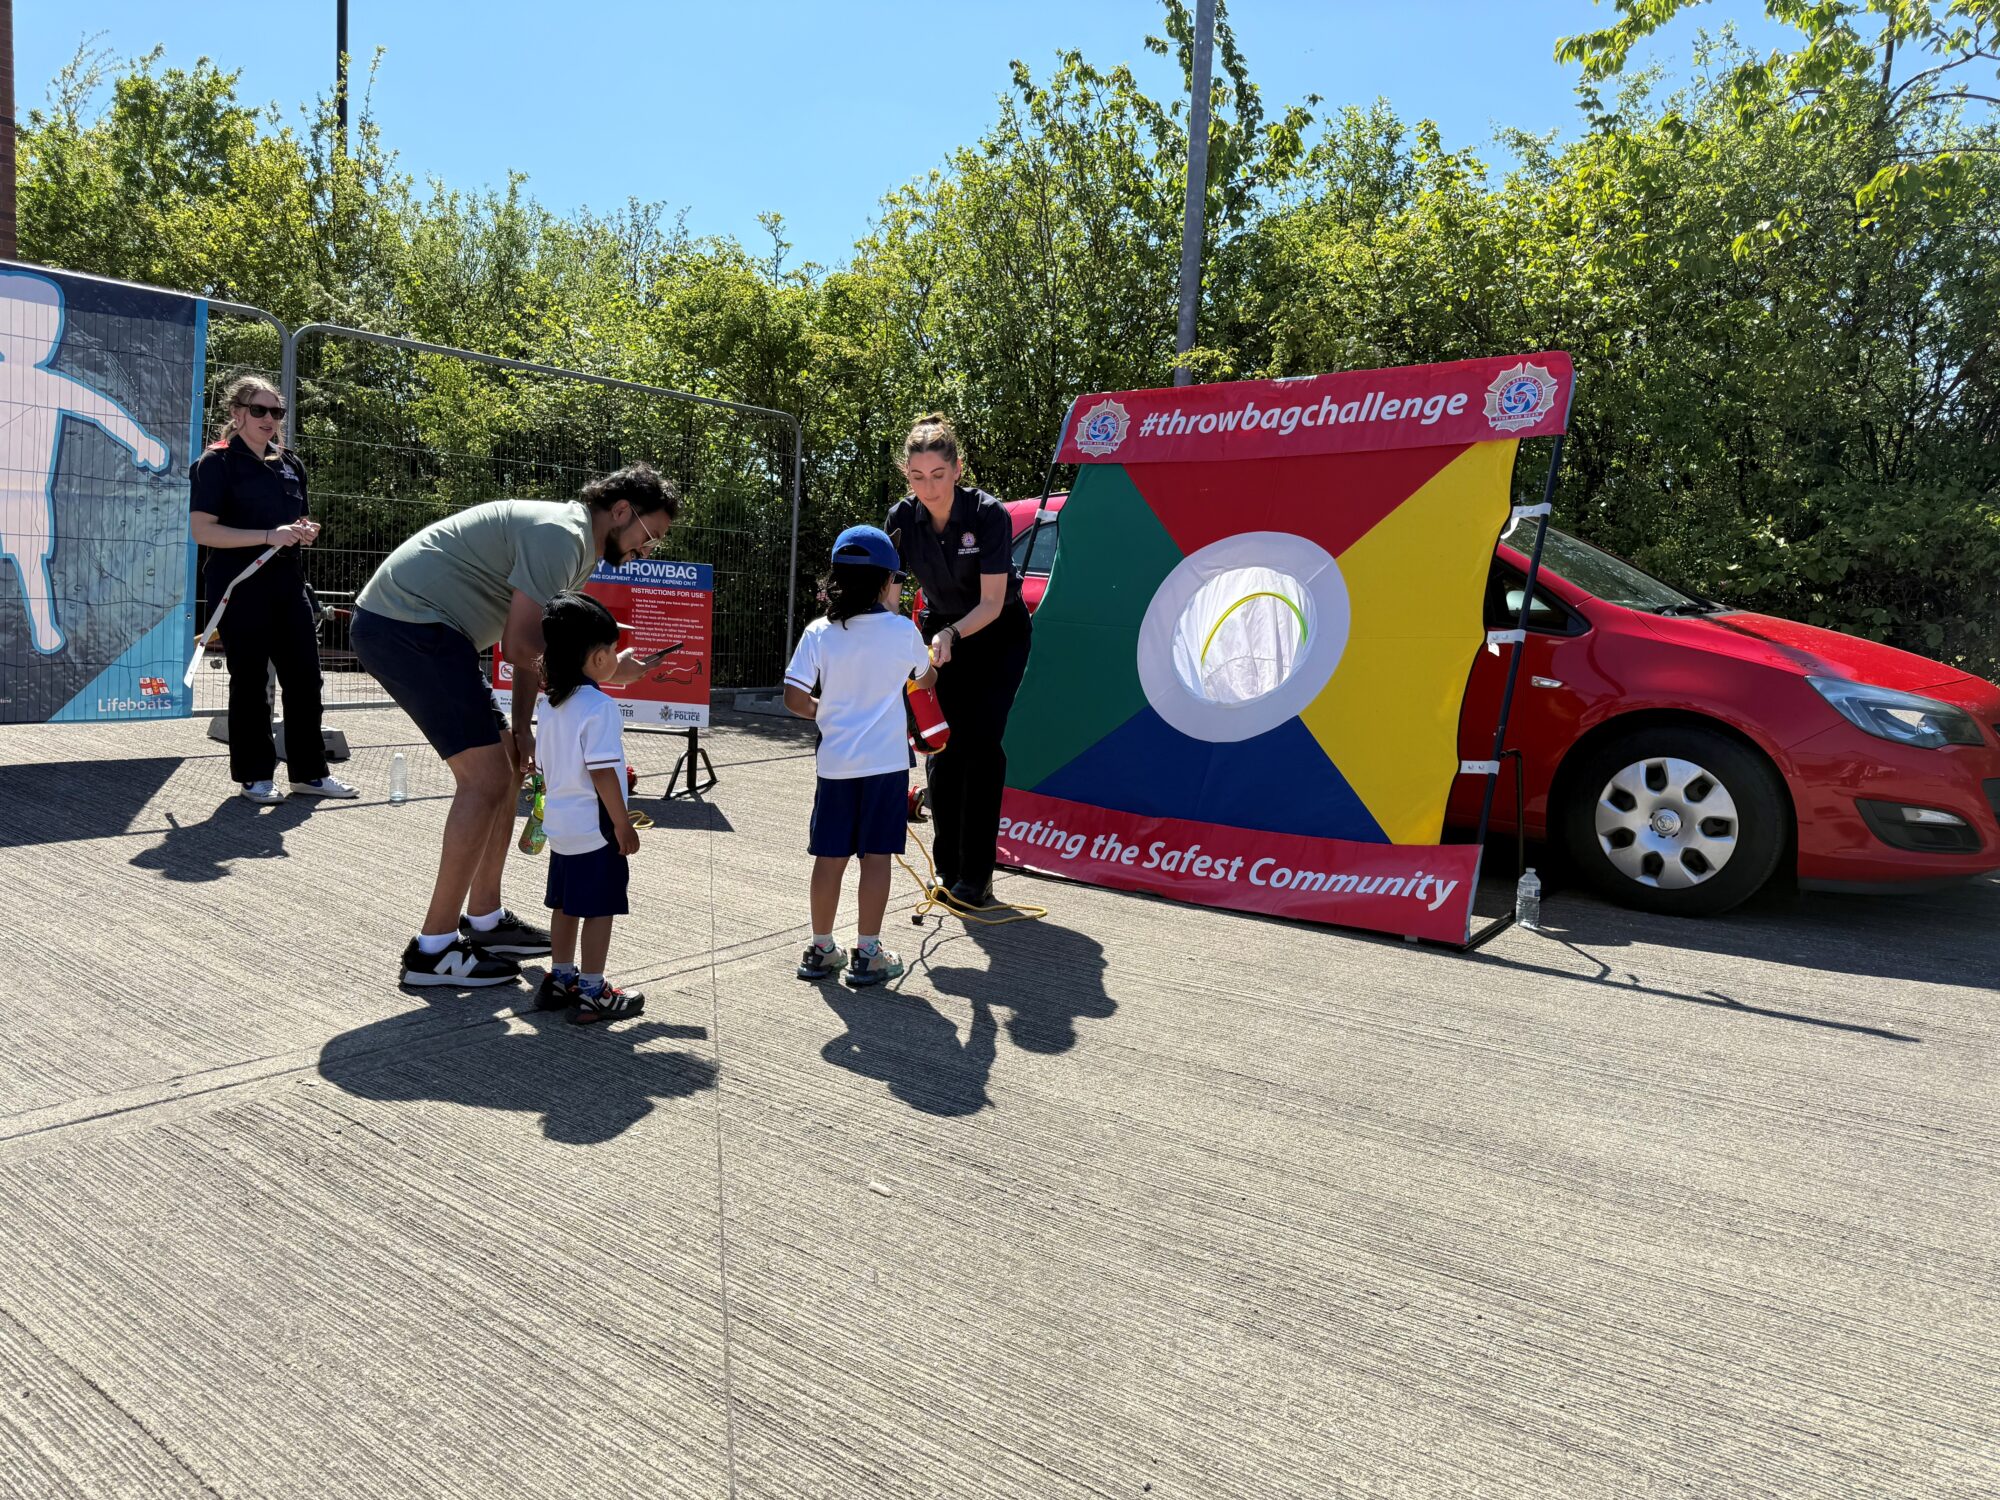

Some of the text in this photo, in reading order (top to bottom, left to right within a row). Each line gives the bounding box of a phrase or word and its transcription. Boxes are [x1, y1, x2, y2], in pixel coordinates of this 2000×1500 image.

[1139, 391, 1468, 436] #throwbagchallenge
[631, 588, 676, 596] INSTRUCTIONS
[98, 697, 172, 712] Lifeboats
[1090, 832, 1139, 865] the
[1142, 841, 1244, 882] Safest
[1248, 857, 1458, 911] Community
